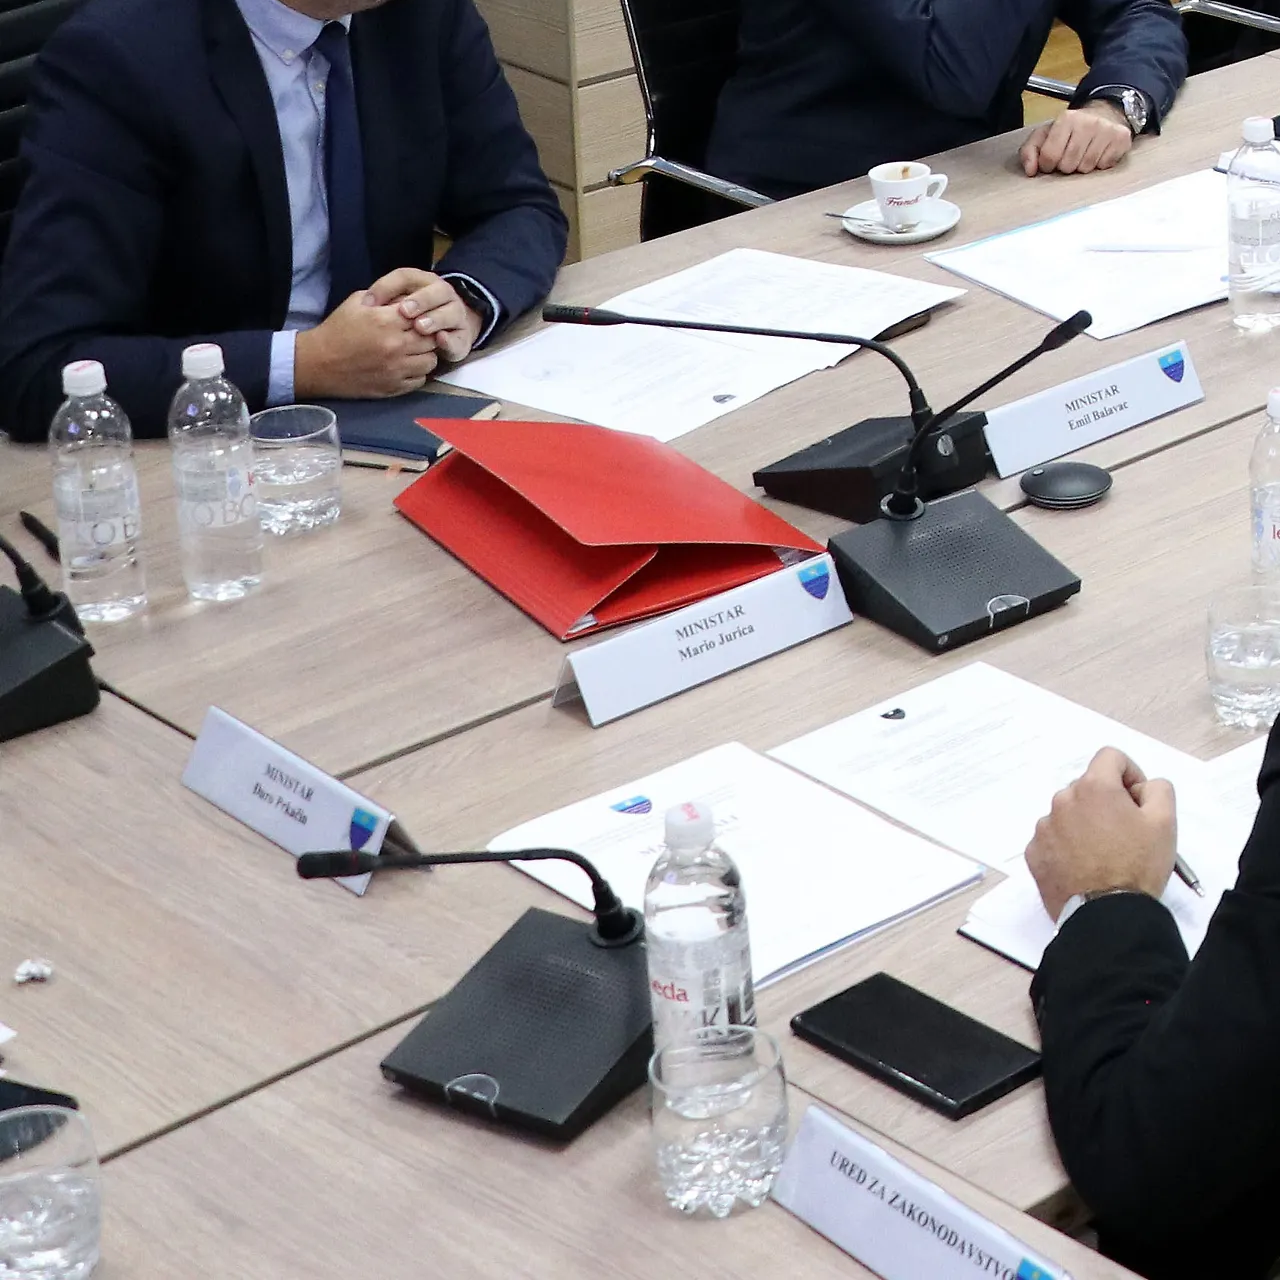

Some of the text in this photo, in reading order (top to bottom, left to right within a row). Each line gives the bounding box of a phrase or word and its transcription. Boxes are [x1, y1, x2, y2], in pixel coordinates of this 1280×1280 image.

[1064, 384, 1120, 413] MINISTAR
[1067, 401, 1129, 431] Emil Balavac
[674, 604, 746, 641] MINISTAR
[678, 624, 755, 662] Mario Jurica
[264, 763, 315, 802] MINISTAR
[651, 978, 690, 1003] eda
[829, 1150, 1017, 1280] URED ZA ZAKONODAVSTVO
